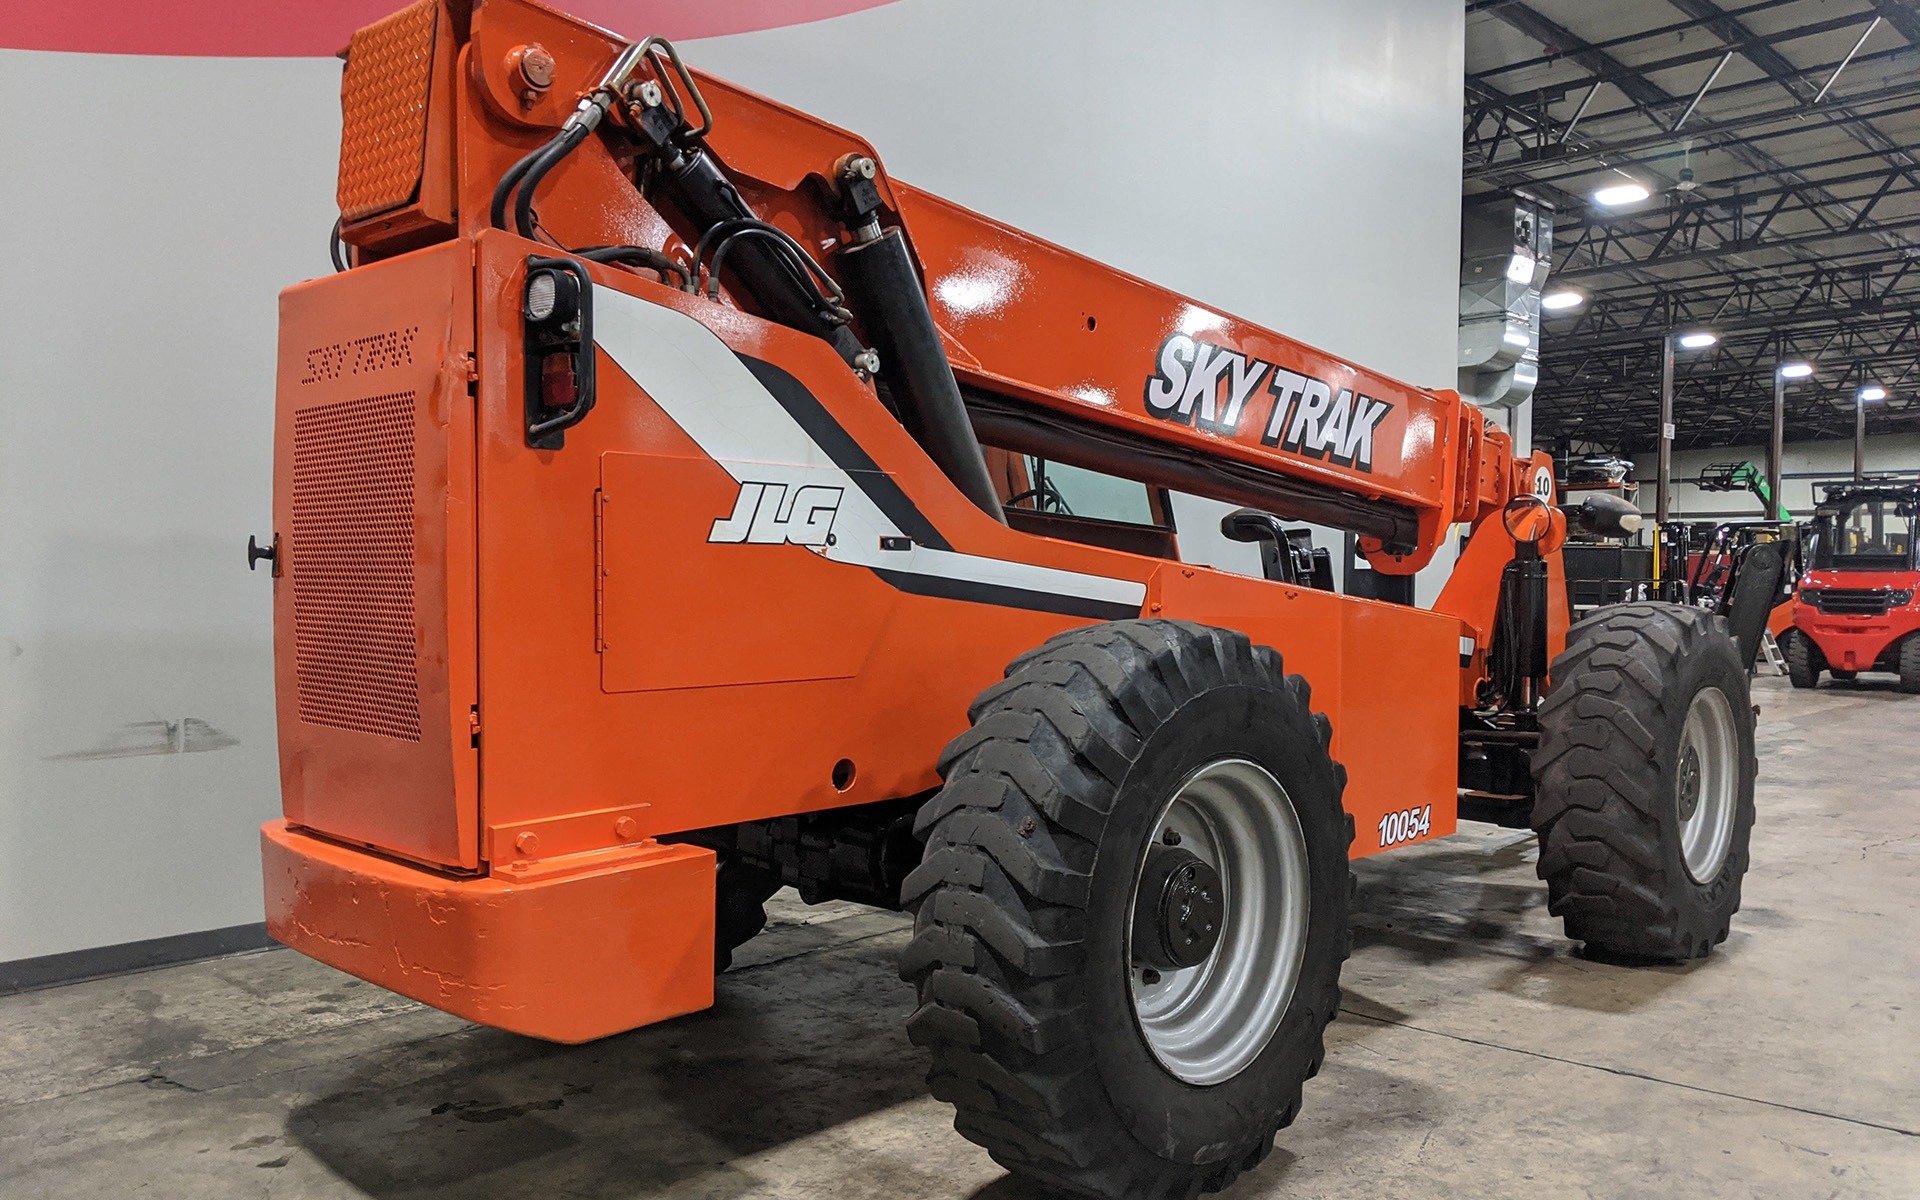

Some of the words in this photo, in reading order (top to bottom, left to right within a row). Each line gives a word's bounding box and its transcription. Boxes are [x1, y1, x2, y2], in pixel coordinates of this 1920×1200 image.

[301, 341, 352, 385] SKY
[352, 326, 419, 375] TRAK
[1145, 332, 1269, 437] SKY
[1261, 365, 1394, 473] TRAK
[706, 481, 844, 546] JLG
[1536, 475, 1550, 496] 10
[1378, 804, 1431, 848] 10054
